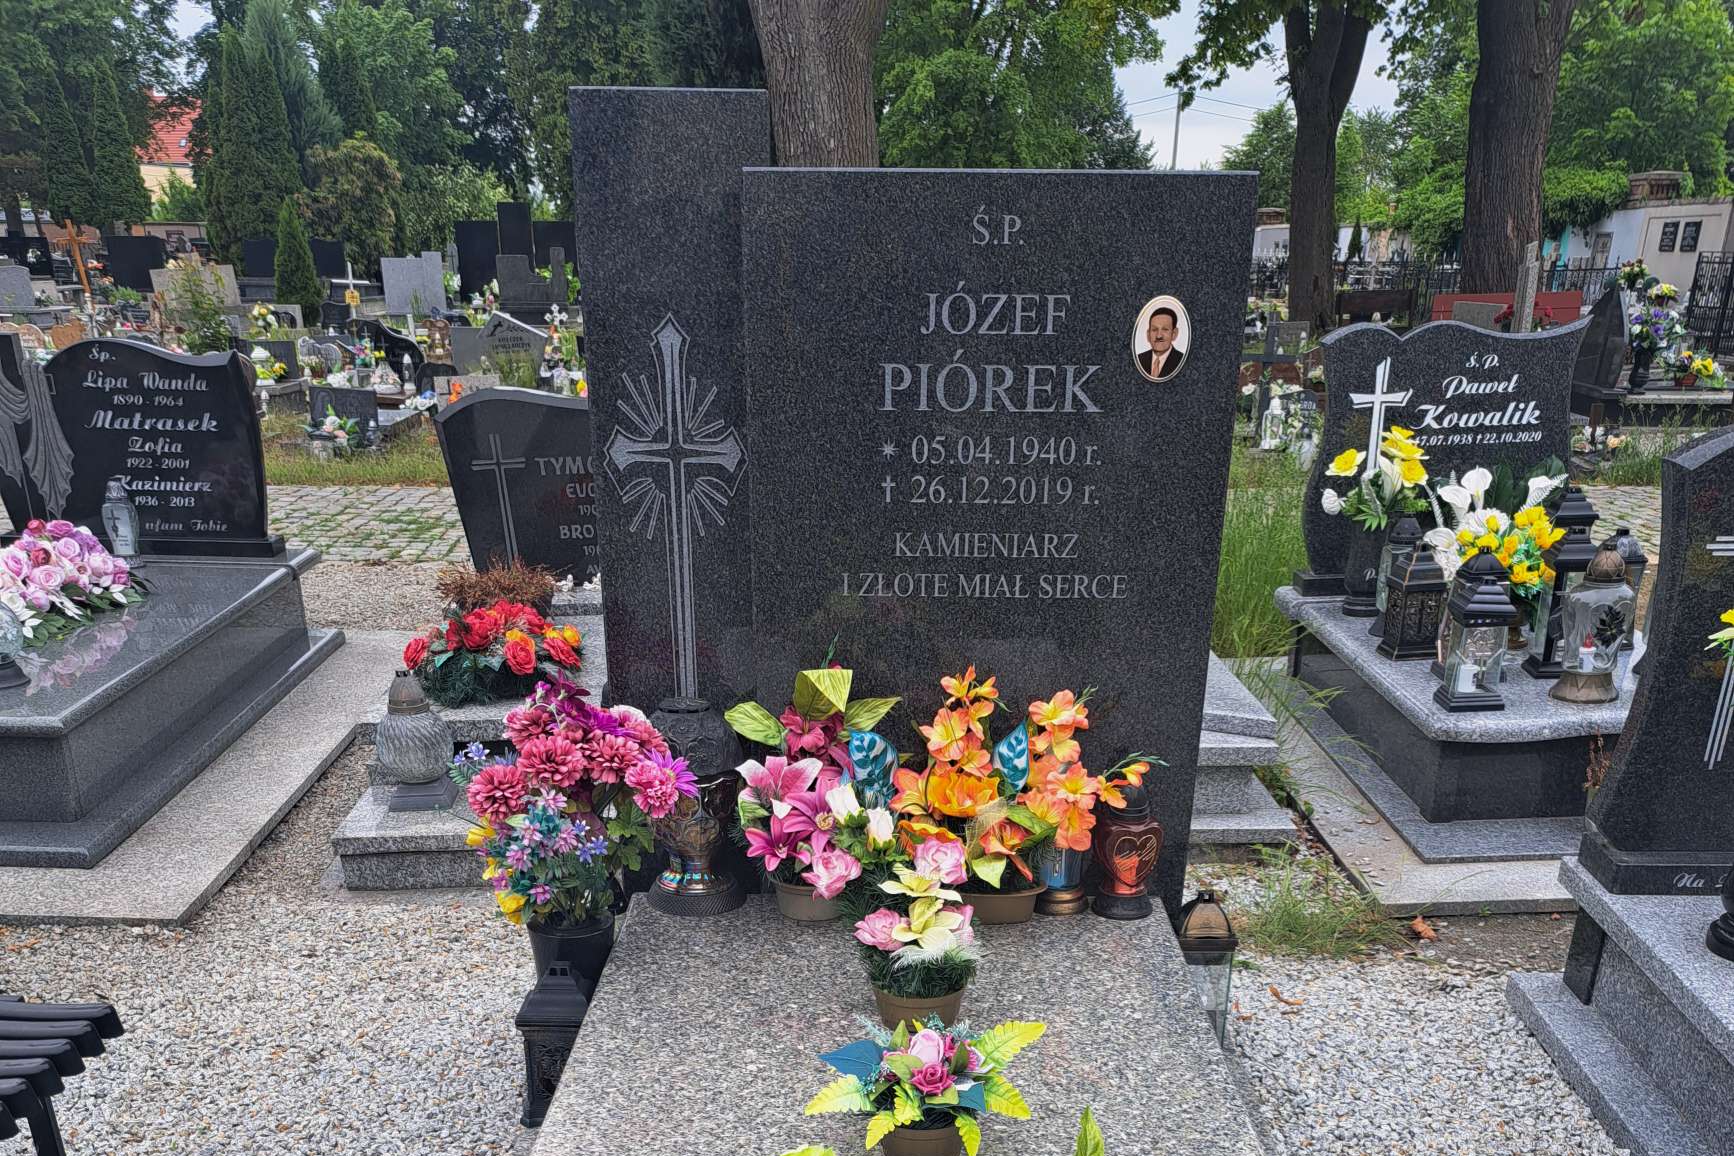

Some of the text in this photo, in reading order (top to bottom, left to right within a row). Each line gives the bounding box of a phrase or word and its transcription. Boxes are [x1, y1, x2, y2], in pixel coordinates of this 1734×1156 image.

[972, 204, 1024, 245] Ś.P.
[920, 280, 1071, 335] JÓZEF
[82, 370, 209, 391] Lipa Wanda
[878, 349, 1105, 413] PIÓREK
[1442, 374, 1520, 399] Paweł
[112, 394, 143, 406] 1890
[153, 395, 184, 407] 1964
[85, 410, 218, 432] Matrasek
[1410, 401, 1541, 430] Kowalik
[128, 436, 184, 455] Zofia
[911, 434, 1102, 465] 05.04.1940 r.
[126, 458, 153, 469] 1922
[161, 458, 190, 469] 2001
[109, 475, 213, 492] Kazimierz
[910, 474, 1100, 505] 26.12.2019 r.
[134, 496, 159, 507] 1936
[169, 496, 196, 507] 2013
[191, 519, 230, 532] Tobie
[895, 532, 1080, 558] KAMIENIARZ
[842, 573, 1129, 599] I ZŁOTE MIAŁ SERCE
